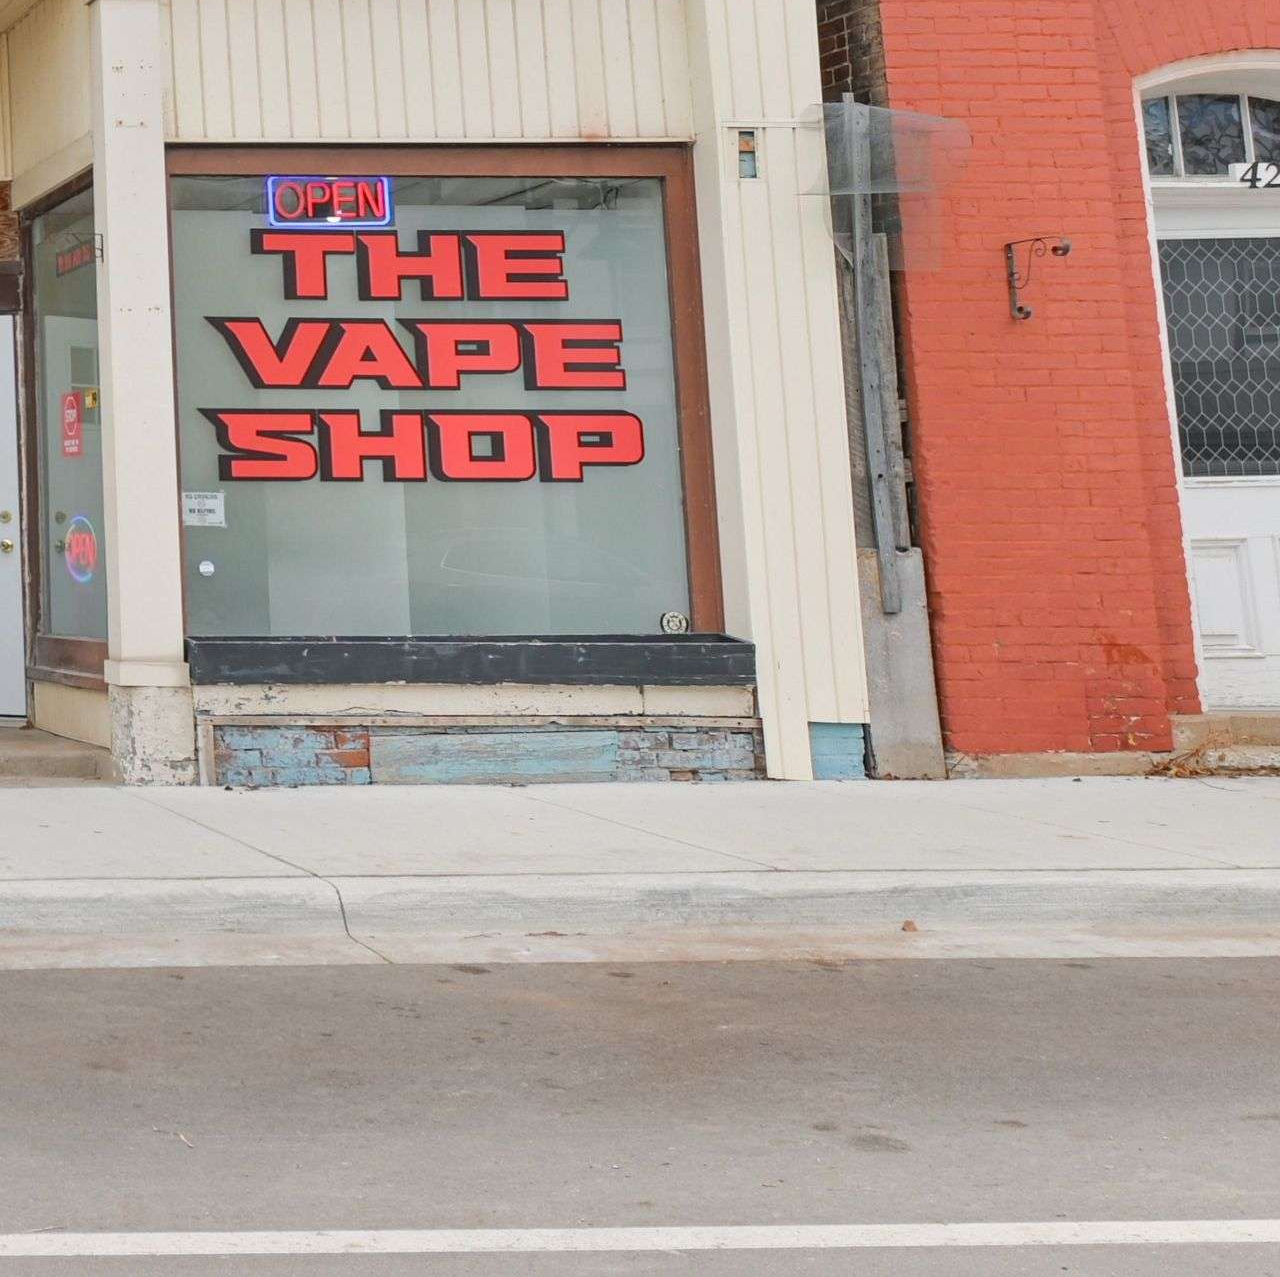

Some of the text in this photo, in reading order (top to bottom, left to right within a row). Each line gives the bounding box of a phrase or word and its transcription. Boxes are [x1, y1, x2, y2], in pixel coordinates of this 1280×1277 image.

[274, 181, 385, 219] OPEN
[1240, 161, 1280, 188] 42
[251, 229, 568, 300] THE
[204, 317, 626, 390] VAPE
[196, 408, 645, 483] SHOP
